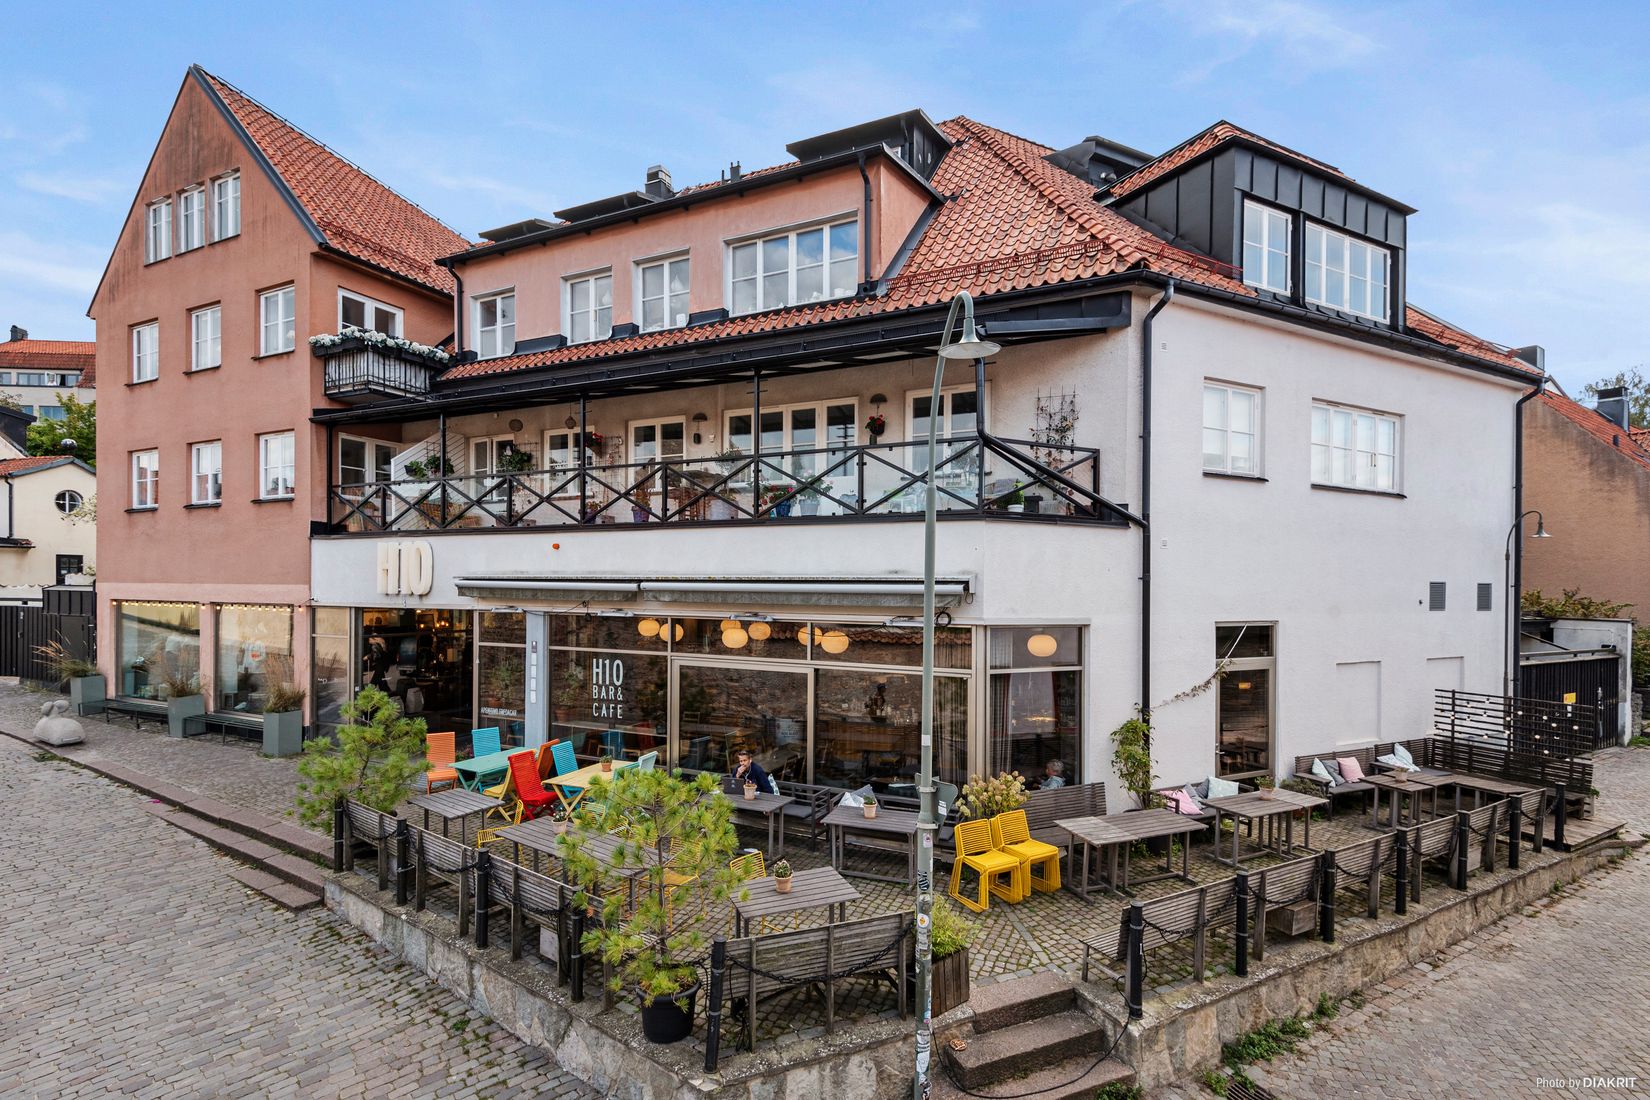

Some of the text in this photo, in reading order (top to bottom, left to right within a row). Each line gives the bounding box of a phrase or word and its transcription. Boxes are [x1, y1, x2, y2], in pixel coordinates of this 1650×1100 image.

[592, 658, 624, 686] H10
[592, 684, 623, 701] BAR&
[592, 702, 623, 719] CAFE
